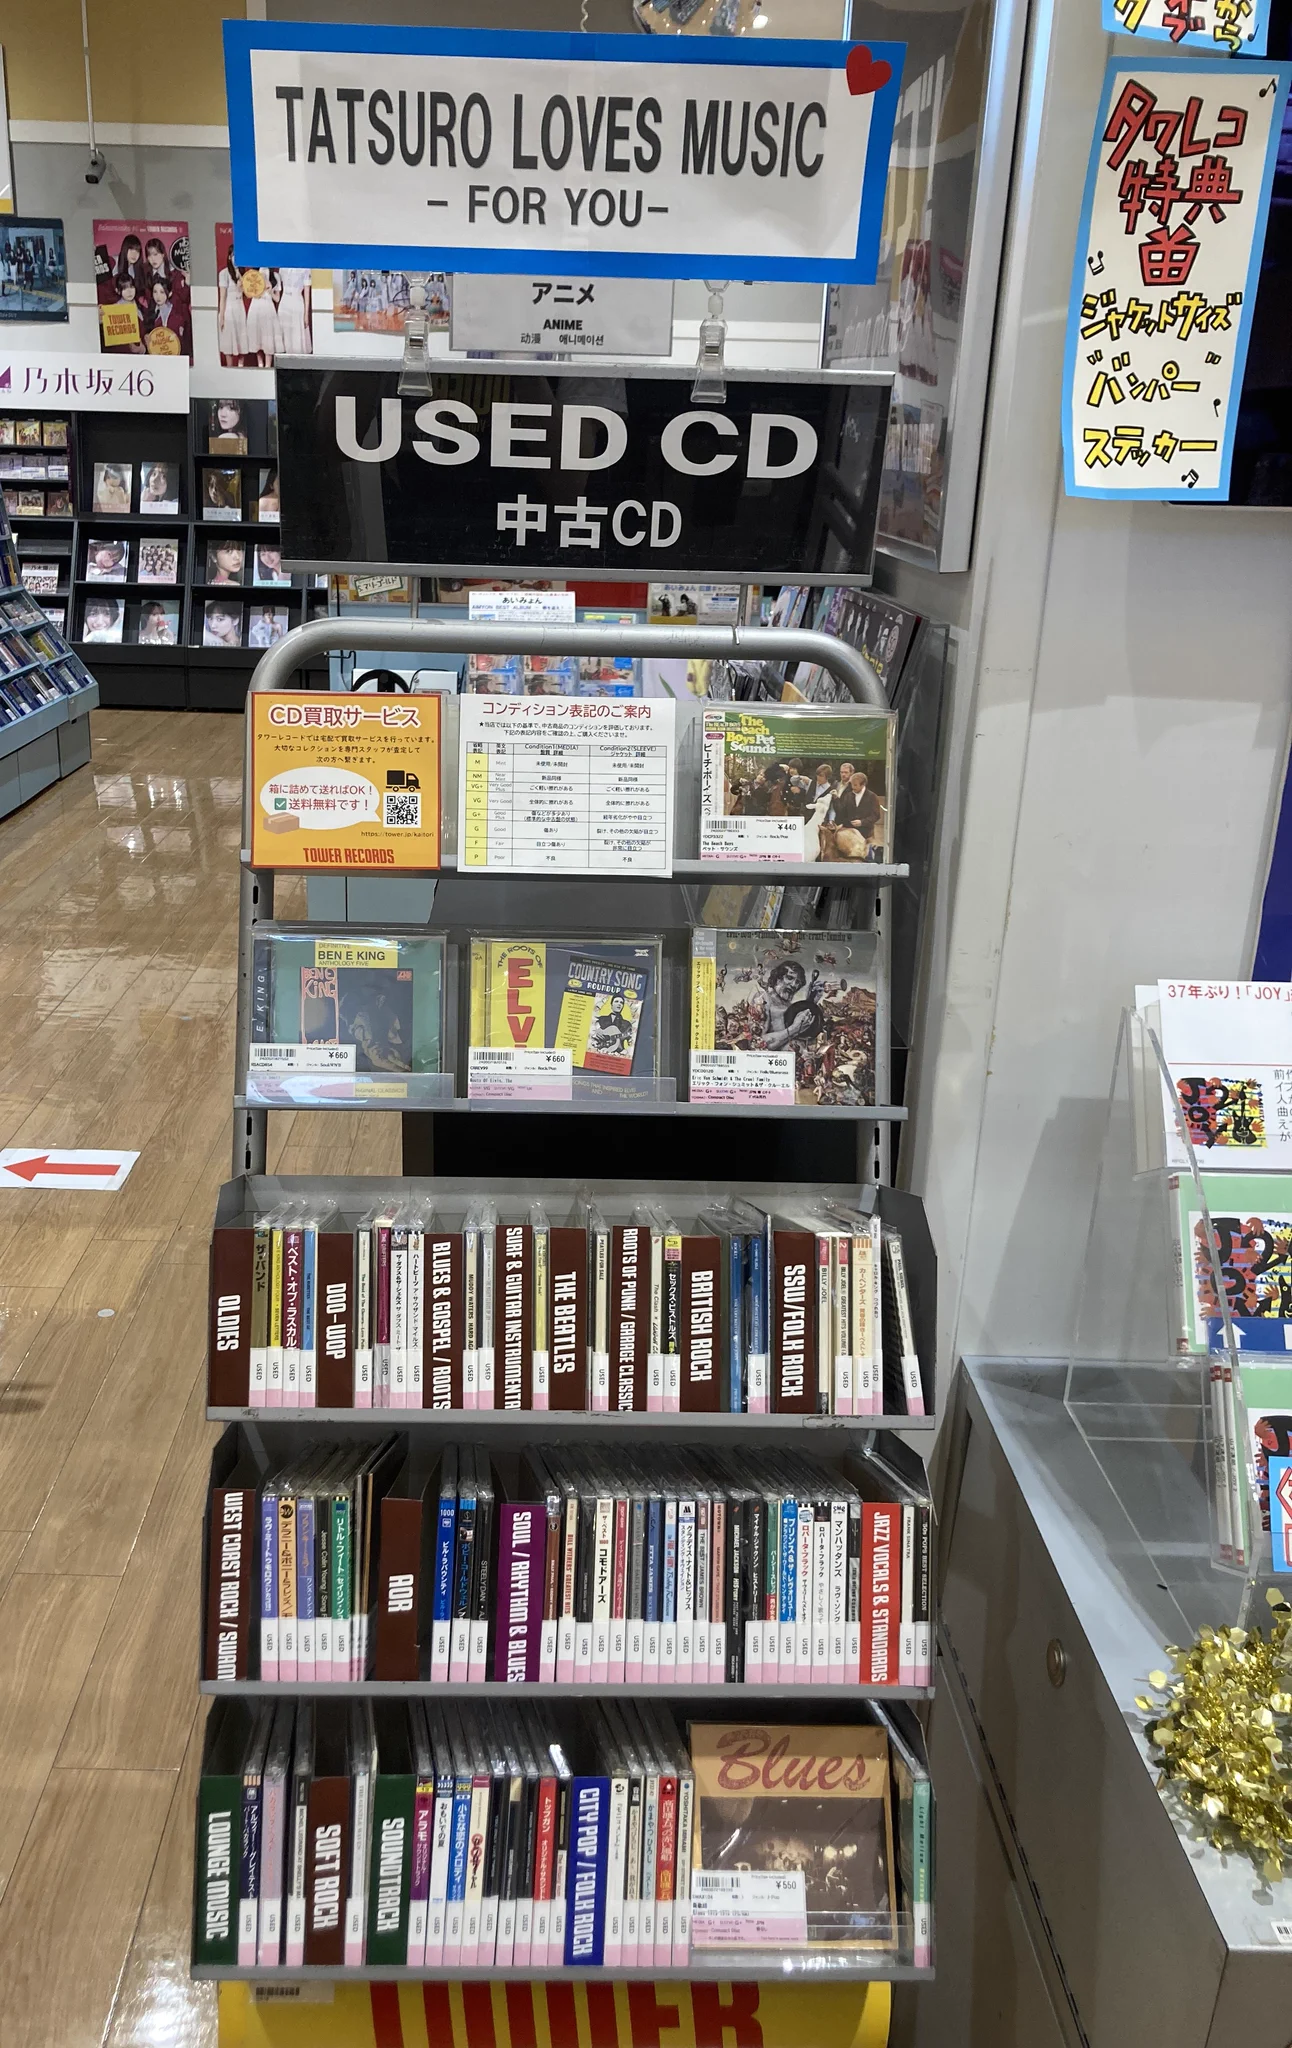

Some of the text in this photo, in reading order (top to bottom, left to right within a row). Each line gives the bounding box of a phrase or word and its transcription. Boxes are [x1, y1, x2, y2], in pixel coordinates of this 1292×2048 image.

[276, 87, 827, 177] TATSURO LOVES MUSIC
[1102, 79, 1248, 171] タワレコ
[468, 186, 545, 224] FOR
[1118, 154, 1243, 235] 特典
[532, 282, 595, 305] アニメ
[106, 323, 137, 336] RECORDS
[107, 313, 132, 325] TOWER
[543, 318, 583, 332] ANIME
[1081, 288, 1243, 341] ジャケットサイズ
[558, 332, 605, 347] 애니메이션
[23, 367, 154, 397] 乃木坂46
[335, 396, 818, 479] USED CD
[1083, 426, 1218, 469] ステッカー
[497, 495, 683, 549] 中古CD
[270, 707, 419, 727] CD買取サービス
[482, 702, 652, 719] コンディション表記のご案内
[726, 732, 776, 744] Boys Pet
[730, 742, 777, 754] Sounds
[289, 799, 369, 811] 送料無料です！
[777, 823, 797, 831] ¥440
[303, 848, 395, 864] TOWER RECORDS
[318, 951, 386, 960] BEN E KING
[507, 945, 535, 956] ROOTS
[568, 962, 613, 985] COUNTRY
[613, 970, 643, 990] SONG
[587, 982, 621, 994] ROUNDUP
[328, 1051, 349, 1059] ¥660
[546, 1055, 565, 1063] ¥660
[506, 1227, 523, 1257] SURF
[622, 1228, 638, 1264] ROOTS
[255, 1244, 266, 1291] ザ・バンド
[432, 1241, 451, 1285] BLUES
[506, 1260, 522, 1272] &
[621, 1265, 637, 1279] OF
[432, 1286, 450, 1299] &
[505, 1273, 522, 1318] GUITAR
[620, 1280, 636, 1311] PUNK
[859, 1267, 867, 1305] カーペンターズ
[217, 1295, 240, 1351] OLDIES
[326, 1283, 346, 1359] DOO-WOP
[553, 1271, 576, 1374] THE BEATLES
[668, 1273, 677, 1340] セックス・ピストルズ
[432, 1301, 451, 1353] GOSPEL
[619, 1321, 635, 1363] GARAGE
[690, 1270, 714, 1382] BRITISH ROCK
[781, 1264, 806, 1397] SSW/FOLK ROCK
[432, 1365, 451, 1409] ROOTS
[223, 1491, 243, 1530] WEST
[440, 1509, 455, 1517] 1000
[511, 1511, 532, 1549] SOUL
[220, 1533, 242, 1577] COAST
[320, 1569, 328, 1590] Young
[388, 1573, 414, 1612] AOR
[509, 1560, 531, 1623] RHYTHM
[597, 1548, 608, 1604] コモドアーズ
[219, 1580, 240, 1619] ROCK
[320, 1595, 328, 1612] Song
[871, 1511, 890, 1683] JAZZ VOCALS & STANDARDS
[508, 1625, 528, 1637] &
[506, 1638, 527, 1683] BLUES
[716, 1728, 871, 1792] Blues
[579, 1787, 600, 1822] CITY
[417, 1810, 428, 1841] アラモ
[454, 1803, 468, 1882] 小さな恋のメロディ
[577, 1826, 597, 1860] POP
[205, 1811, 232, 1940] LOUNGE MUSIC
[313, 1824, 341, 1930] SOFT ROCK
[376, 1817, 404, 1931] SOUNDTRACK
[574, 1868, 596, 1909] FOLK
[775, 1880, 797, 1890] ¥550
[572, 1910, 594, 1957] ROCK
